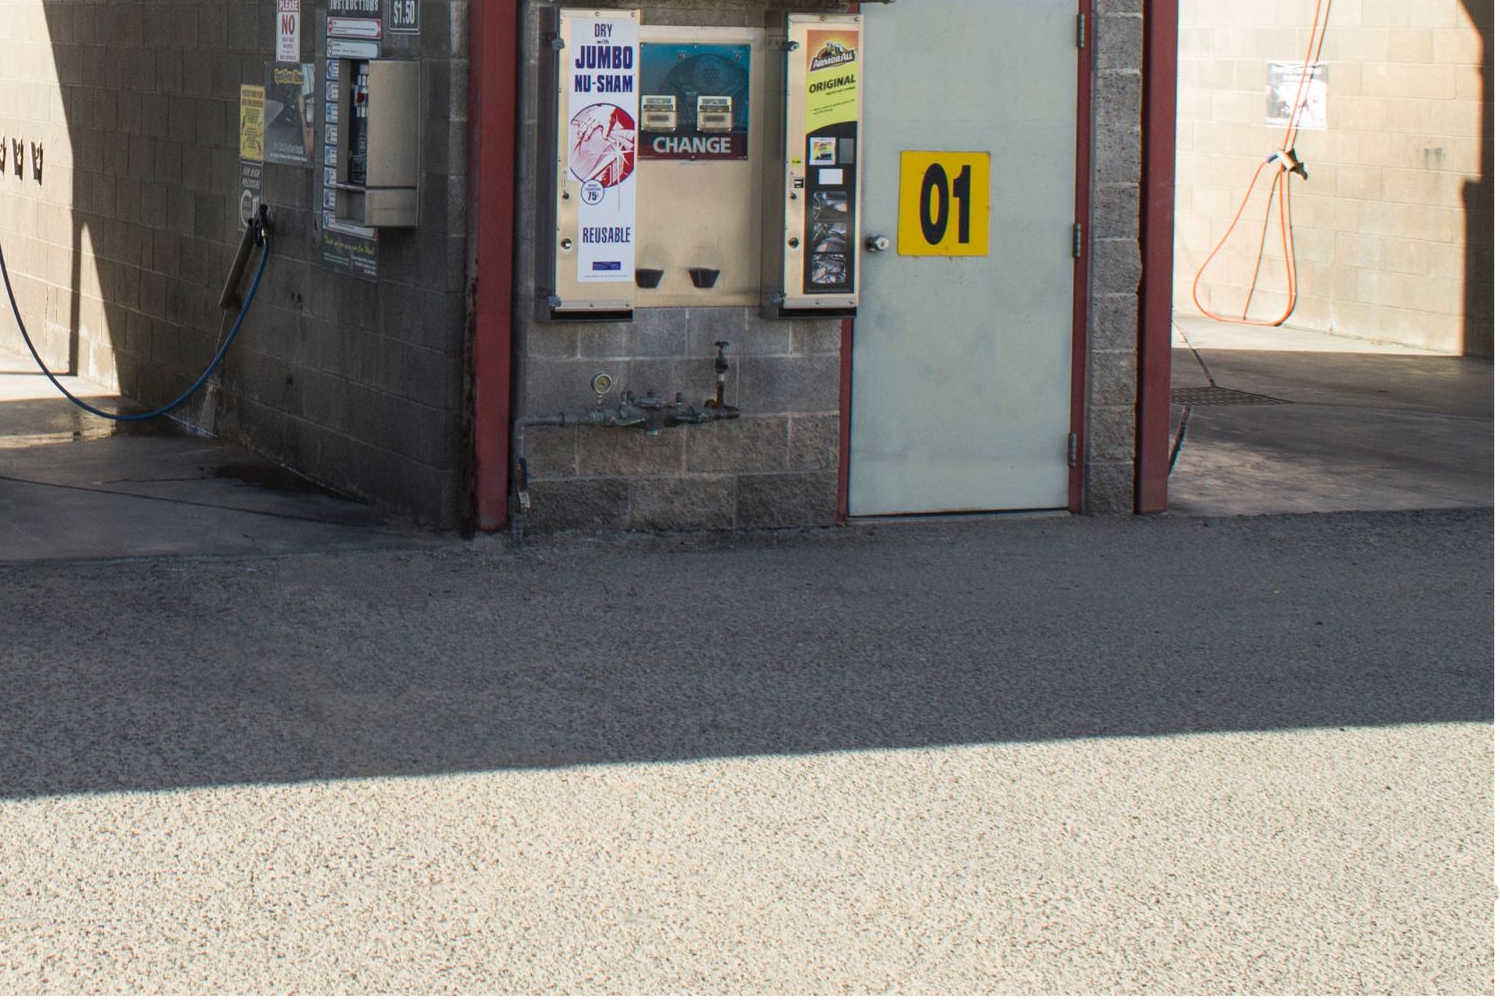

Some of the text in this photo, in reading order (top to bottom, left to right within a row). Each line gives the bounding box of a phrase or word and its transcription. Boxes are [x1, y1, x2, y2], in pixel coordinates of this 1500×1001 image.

[279, 0, 299, 11] PLEASE
[393, 0, 415, 26] $1.50
[281, 14, 295, 35] NO
[594, 23, 613, 37] DRY
[575, 45, 633, 69] JUMBO
[574, 74, 633, 93] NU-SHAM
[809, 74, 856, 94] ORIGINAL
[652, 136, 731, 154] CHANGE
[919, 163, 971, 245] 01
[582, 227, 631, 243] REUSABLE
